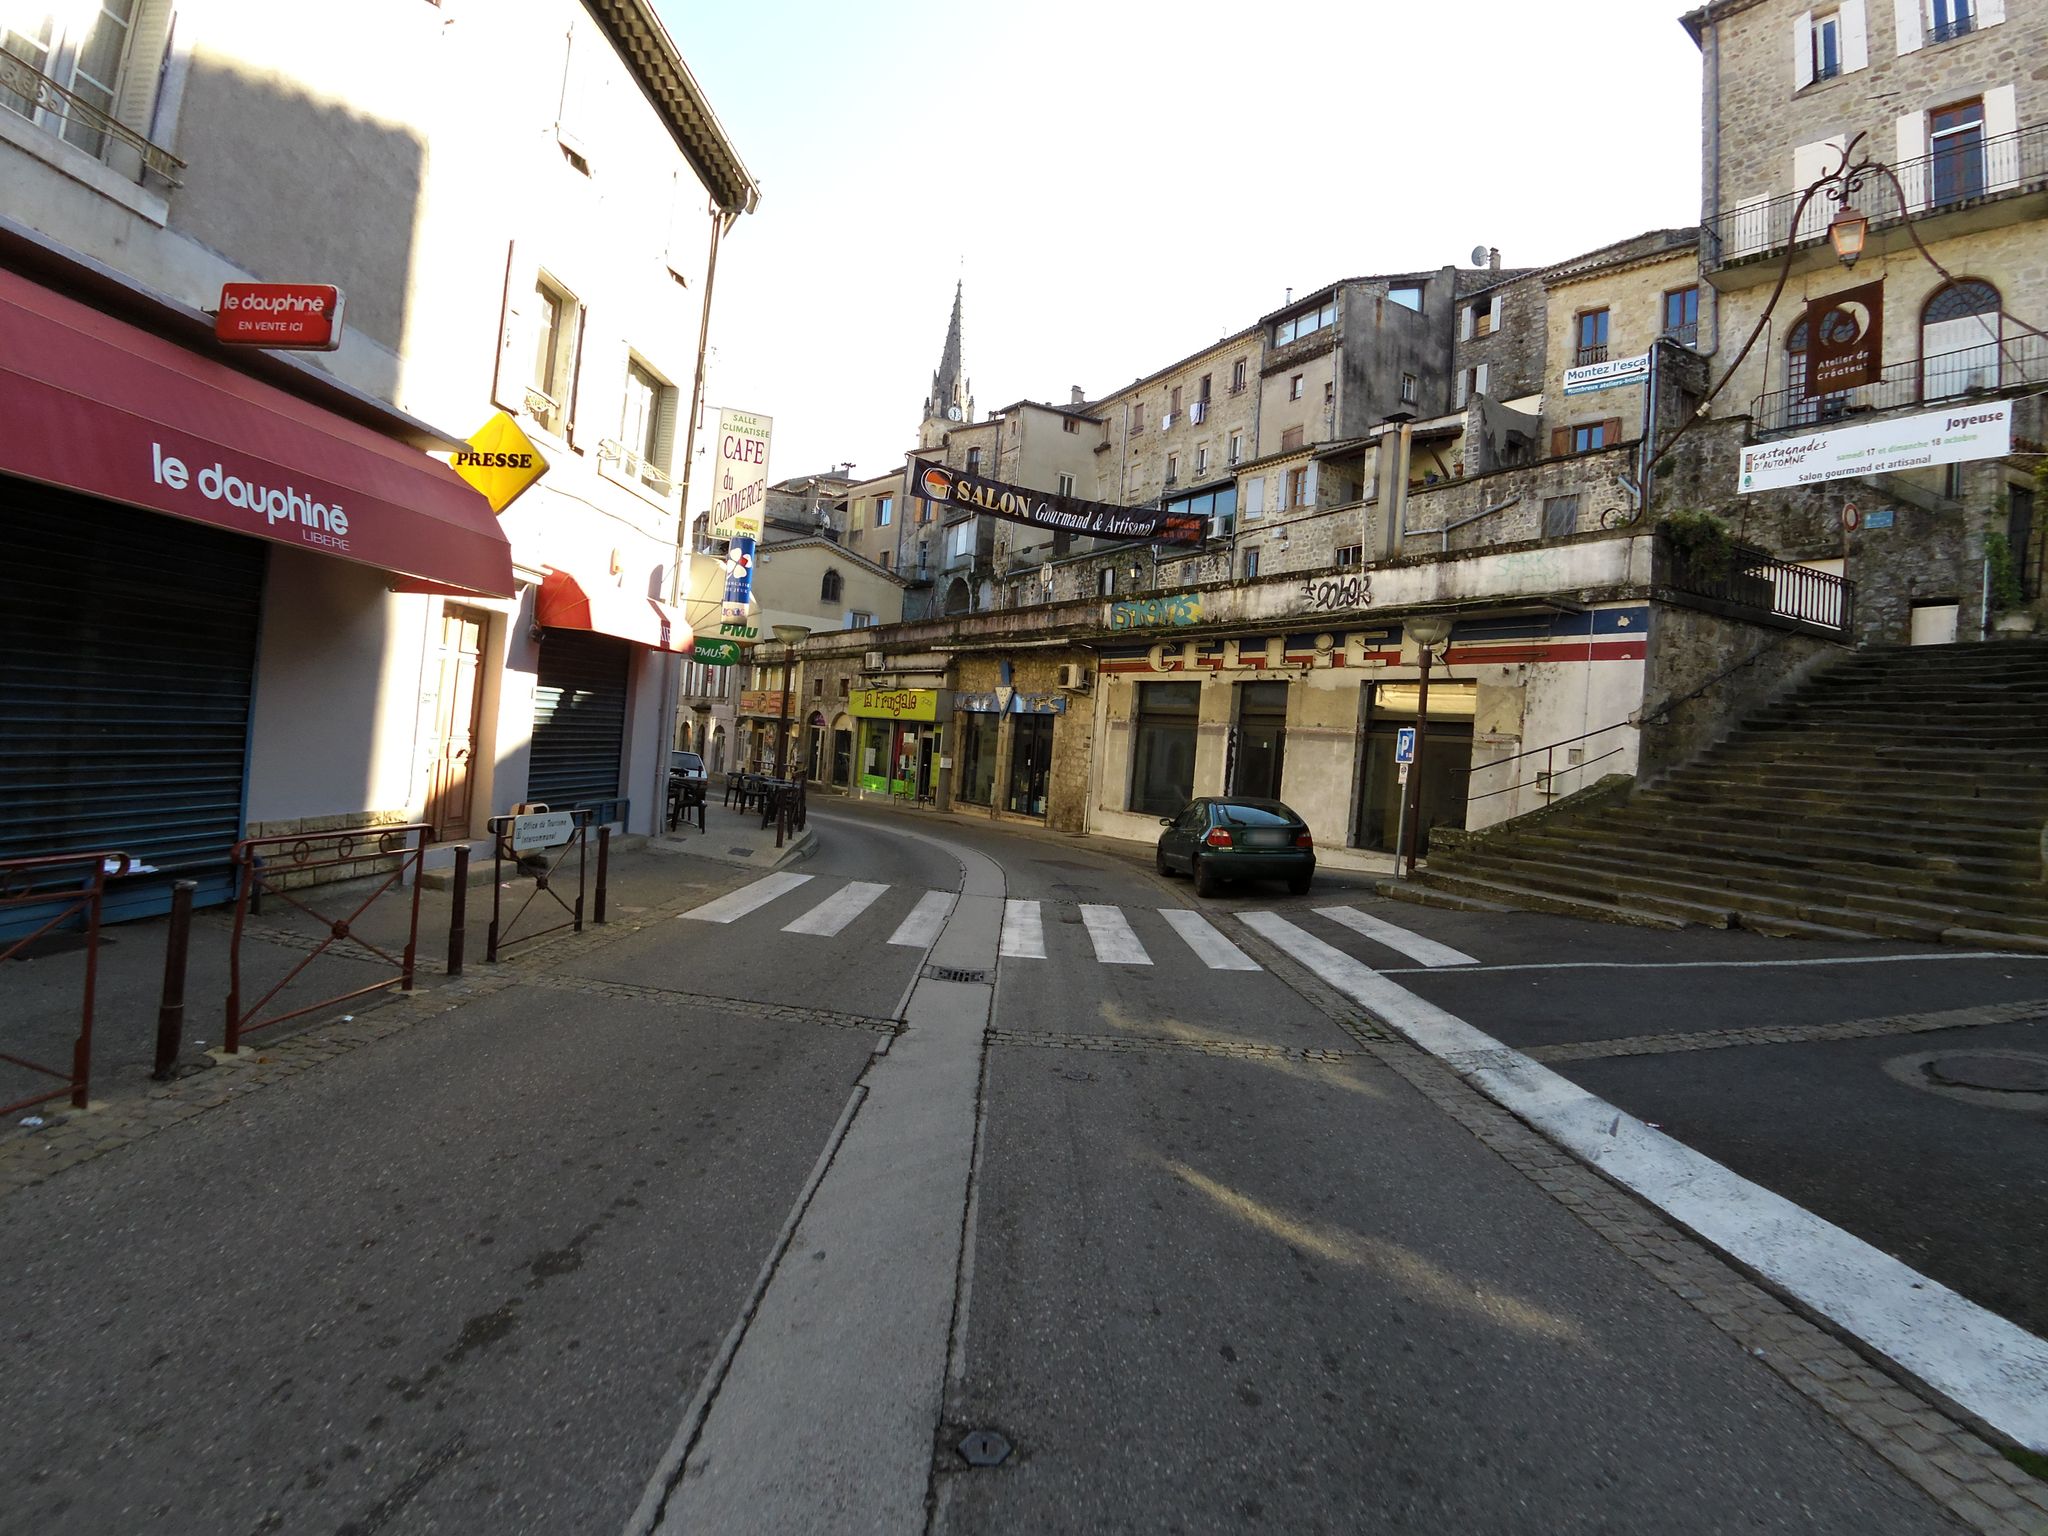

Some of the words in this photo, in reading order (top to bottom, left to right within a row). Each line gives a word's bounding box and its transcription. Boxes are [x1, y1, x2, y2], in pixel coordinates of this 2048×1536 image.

[224, 292, 239, 310] le
[242, 293, 325, 315] dauphiné
[238, 321, 252, 330] EN
[255, 322, 287, 331] VENTE
[289, 322, 303, 331] ICI
[1817, 355, 1854, 369] Atelier
[1856, 350, 1869, 360] de
[1567, 366, 1609, 380] Montez
[732, 414, 757, 426] SALLE
[1946, 411, 2004, 431] Joyeuse
[723, 435, 765, 465] CAFE
[1866, 448, 1876, 456] 17
[1888, 441, 1929, 453] dimanche
[1931, 438, 1942, 446] 18
[456, 452, 532, 468] PRESSE
[1754, 454, 1807, 471] D'AUTOMNE
[1798, 471, 1823, 482] Salon
[1825, 463, 1873, 480] gourmand
[1875, 462, 1886, 471] et
[1888, 454, 1932, 469] artisanal
[723, 467, 734, 490] du
[152, 442, 189, 490] le
[198, 463, 349, 536] dauphiné
[714, 479, 764, 526] COMMERCE
[956, 480, 1032, 518] SALON
[1035, 502, 1092, 529] Gourmand
[1092, 513, 1103, 531] &
[1104, 515, 1156, 537] Artisanal
[720, 623, 758, 638] PMU
[695, 646, 718, 658] PMU
[1400, 735, 1409, 757] P
